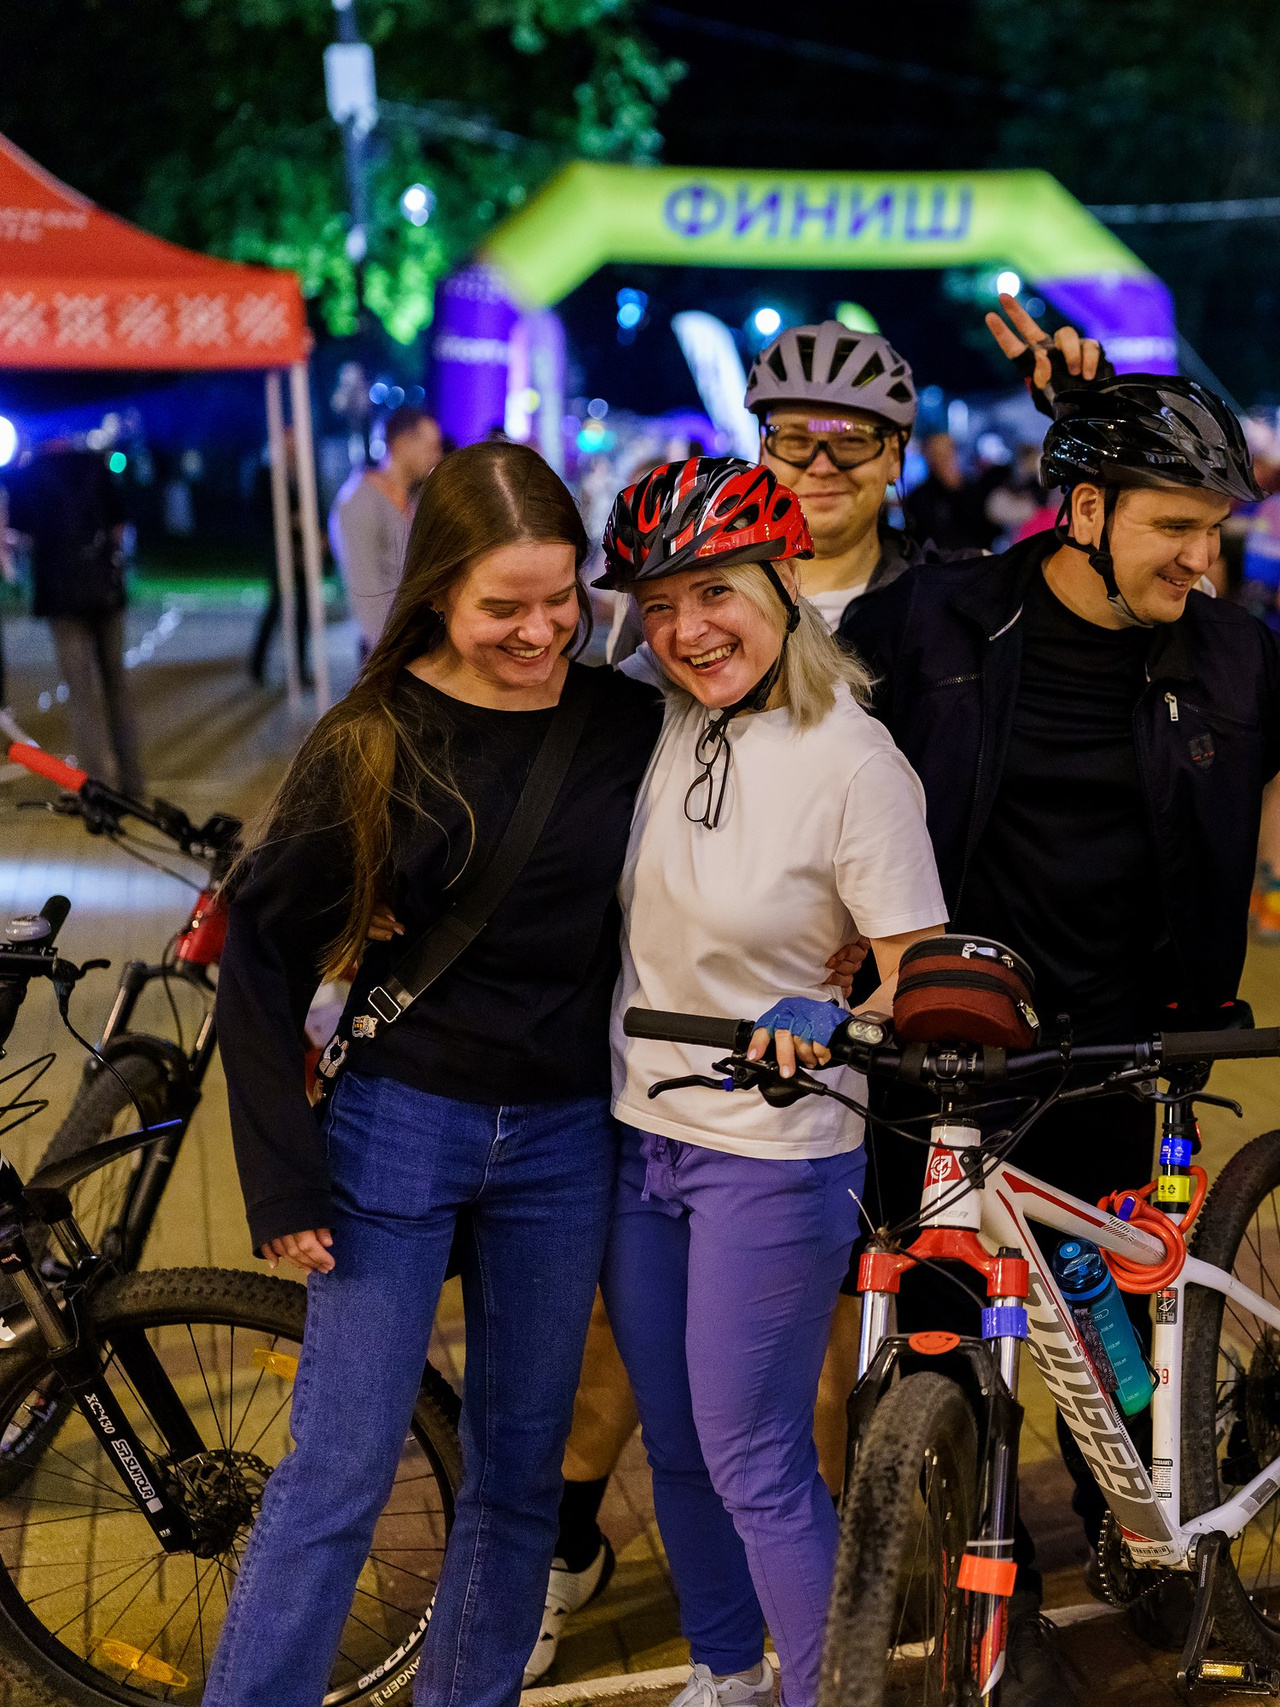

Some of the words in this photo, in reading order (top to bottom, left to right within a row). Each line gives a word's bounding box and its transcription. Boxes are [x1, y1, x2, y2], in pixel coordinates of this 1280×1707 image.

[662, 177, 974, 243] ФИНИШ
[124, 1456, 156, 1499] SUNTOUR
[381, 1655, 421, 1699] ANGER
